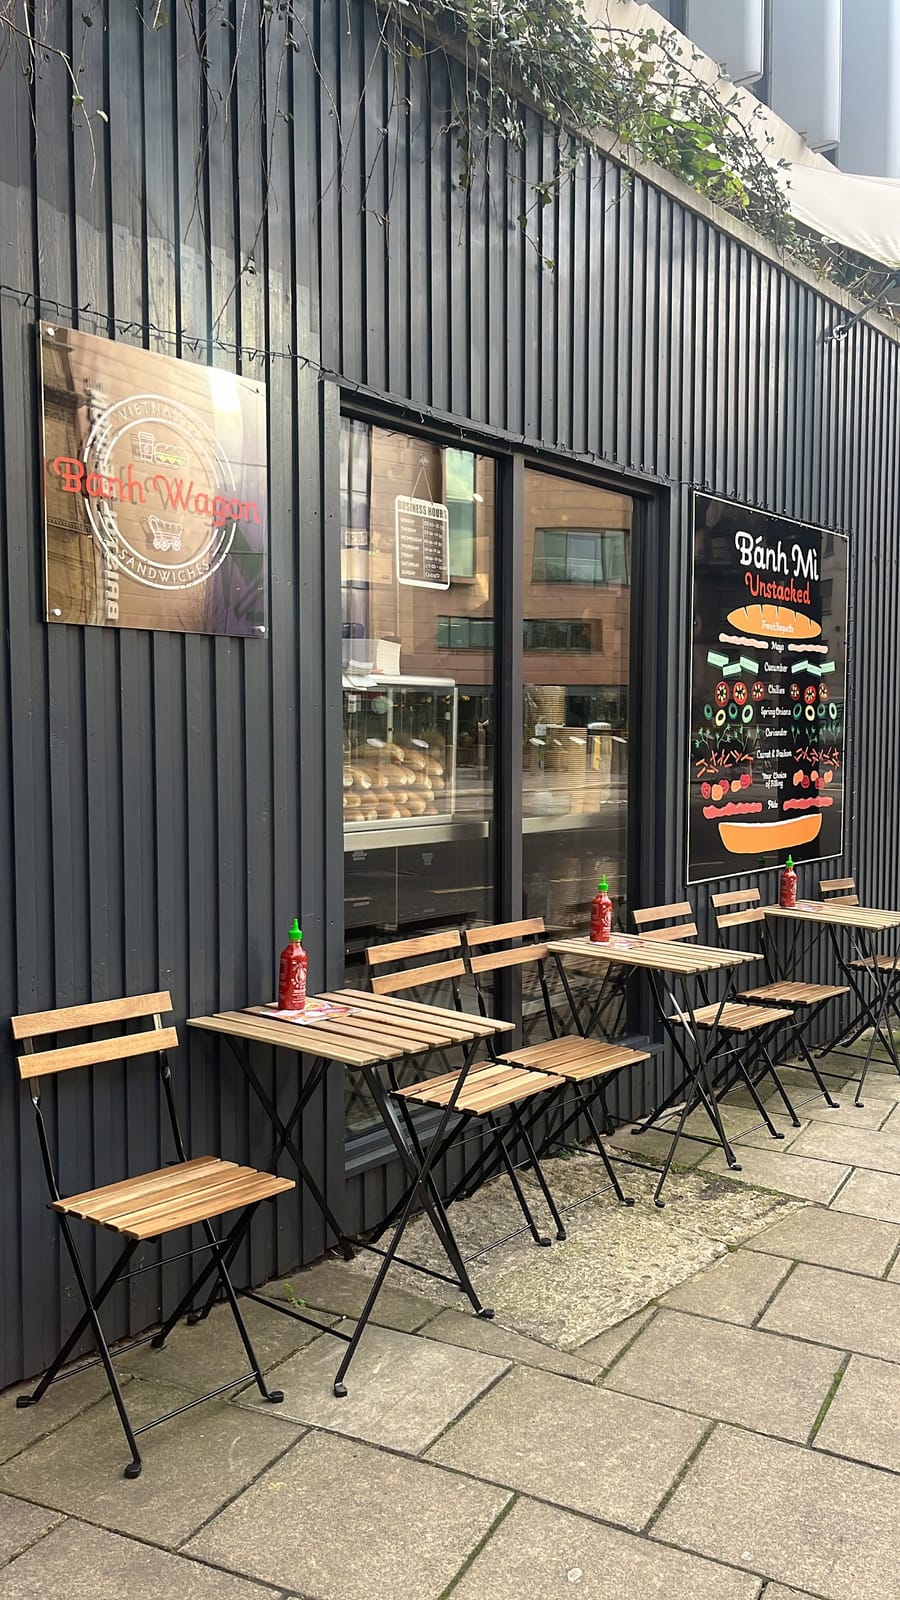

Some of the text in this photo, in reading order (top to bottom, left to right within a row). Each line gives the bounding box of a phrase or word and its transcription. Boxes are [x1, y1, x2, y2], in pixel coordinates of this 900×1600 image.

[152, 474, 260, 526] Wagon
[397, 499, 447, 519] BUSINESS HOURS
[735, 531, 789, 576] Bánh
[118, 549, 209, 583] SANDWICHES
[744, 571, 811, 605] Unstacked
[771, 641, 785, 653] Mayo
[764, 661, 789, 673] Cucumber
[767, 684, 786, 695] Chillies
[760, 705, 792, 719] Spring Onions
[765, 727, 788, 737] Coriander
[756, 749, 771, 759] Carrot
[772, 771, 787, 780] Choice
[770, 779, 784, 790] Filling
